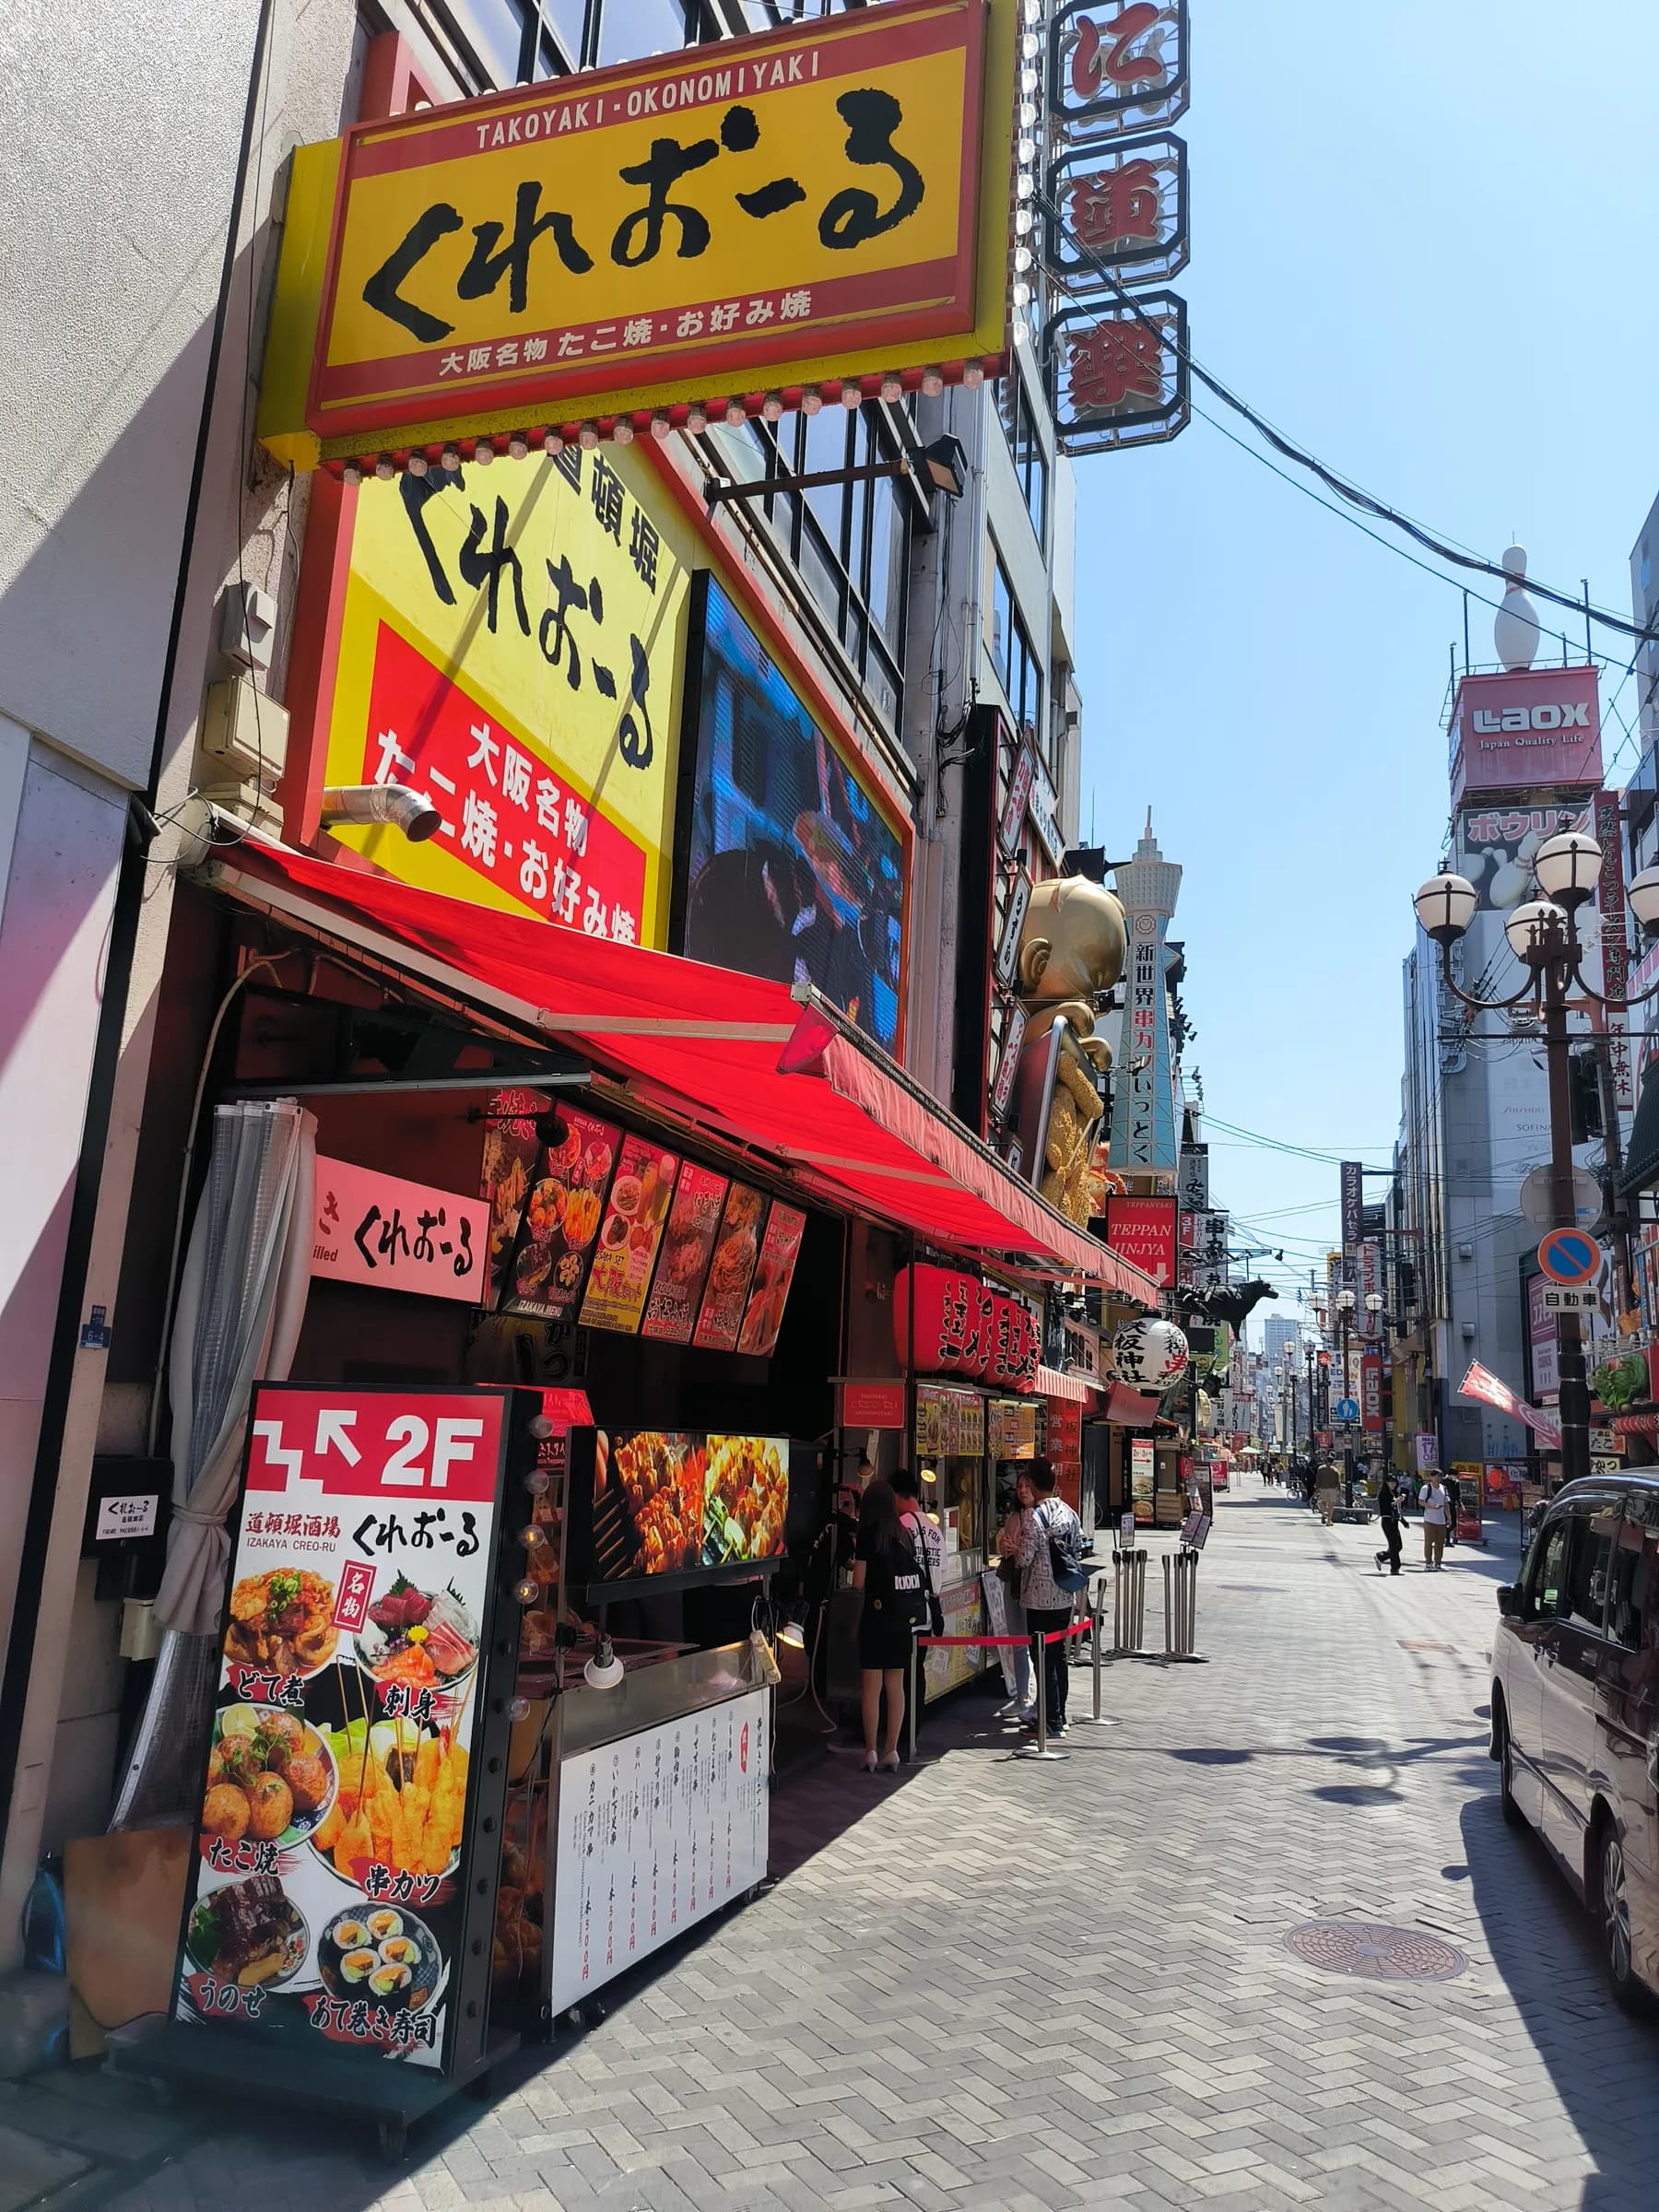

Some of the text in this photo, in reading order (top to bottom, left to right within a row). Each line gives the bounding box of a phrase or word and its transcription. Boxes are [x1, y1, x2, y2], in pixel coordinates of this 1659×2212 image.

[363, 88, 924, 344] くれおーる
[1478, 734, 1584, 752] Japan Quality Life
[467, 723, 588, 857] 大阪名物
[1610, 1023, 1631, 1095] 年中無休
[354, 1205, 473, 1277] くれおーる
[1111, 1224, 1172, 1237] TEPPAN
[1546, 1292, 1597, 1307] 自動車
[381, 1415, 483, 1487] 2F
[245, 1508, 480, 1557] 道頓堀酒場 くれおーる
[247, 1539, 335, 1552] IZAKAYA CREO-RU
[342, 1572, 365, 1618] 名物
[237, 1670, 305, 1706] どて煮
[383, 1686, 436, 1719] 刺身
[209, 1838, 280, 1877] たこ焼
[365, 1866, 441, 1903] 串カツ
[310, 2000, 437, 2049] あて巻き寿司
